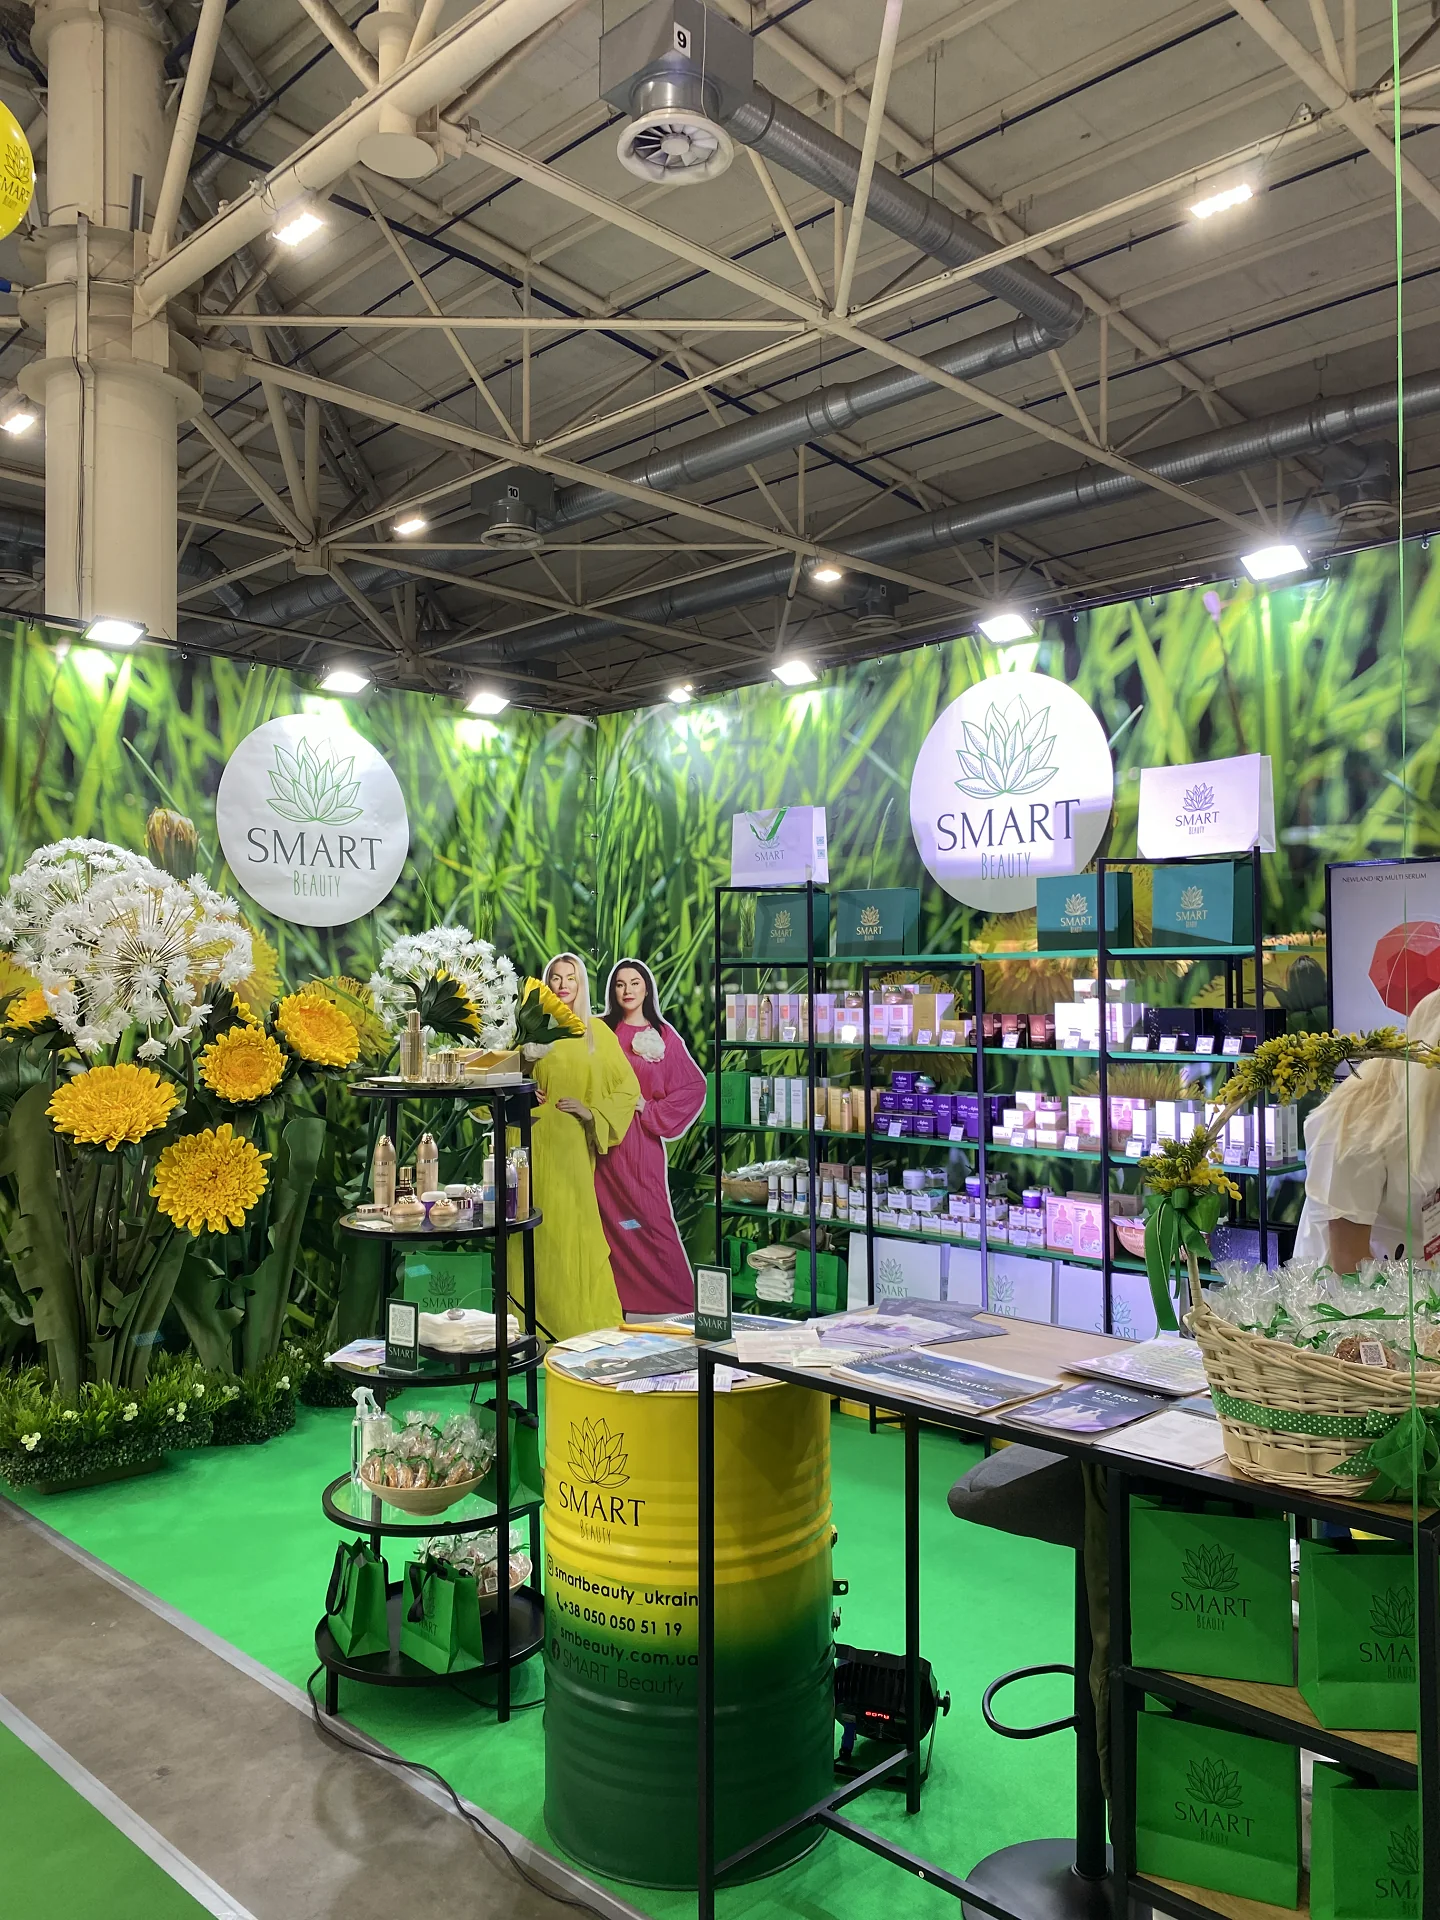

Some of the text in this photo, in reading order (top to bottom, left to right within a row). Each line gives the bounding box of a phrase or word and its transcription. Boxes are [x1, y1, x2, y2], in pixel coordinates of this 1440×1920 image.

[677, 30, 687, 49] 9
[0, 175, 30, 204] MART
[508, 487, 518, 498] 10
[936, 798, 1081, 852] SMART
[1175, 811, 1220, 828] SMART
[246, 827, 383, 871] SMART
[754, 850, 785, 862] SMART
[1342, 875, 1374, 883] NEWLAND
[1385, 873, 1404, 881] MULTI
[1404, 872, 1427, 880] SERUM
[1060, 915, 1093, 927] SMART
[1175, 909, 1209, 922] SMART
[770, 928, 794, 939] SMART
[856, 925, 883, 936] SMART
[875, 1282, 909, 1298] SMART
[698, 1316, 729, 1331] SMART
[1094, 1322, 1139, 1340] SART
[388, 1346, 415, 1360] SMART
[558, 1481, 646, 1527] SMART
[579, 1518, 612, 1545] BEAUTY
[555, 1566, 698, 1607] smartbeauty_ukrain
[1170, 1590, 1252, 1618] SMART
[563, 1600, 683, 1637] +38 050 050 51 19
[560, 1626, 698, 1666] smbeauty.com.ua
[1359, 1642, 1414, 1663] SMA
[562, 1648, 684, 1696] SMART Beauty
[1174, 1801, 1256, 1838] SMART
